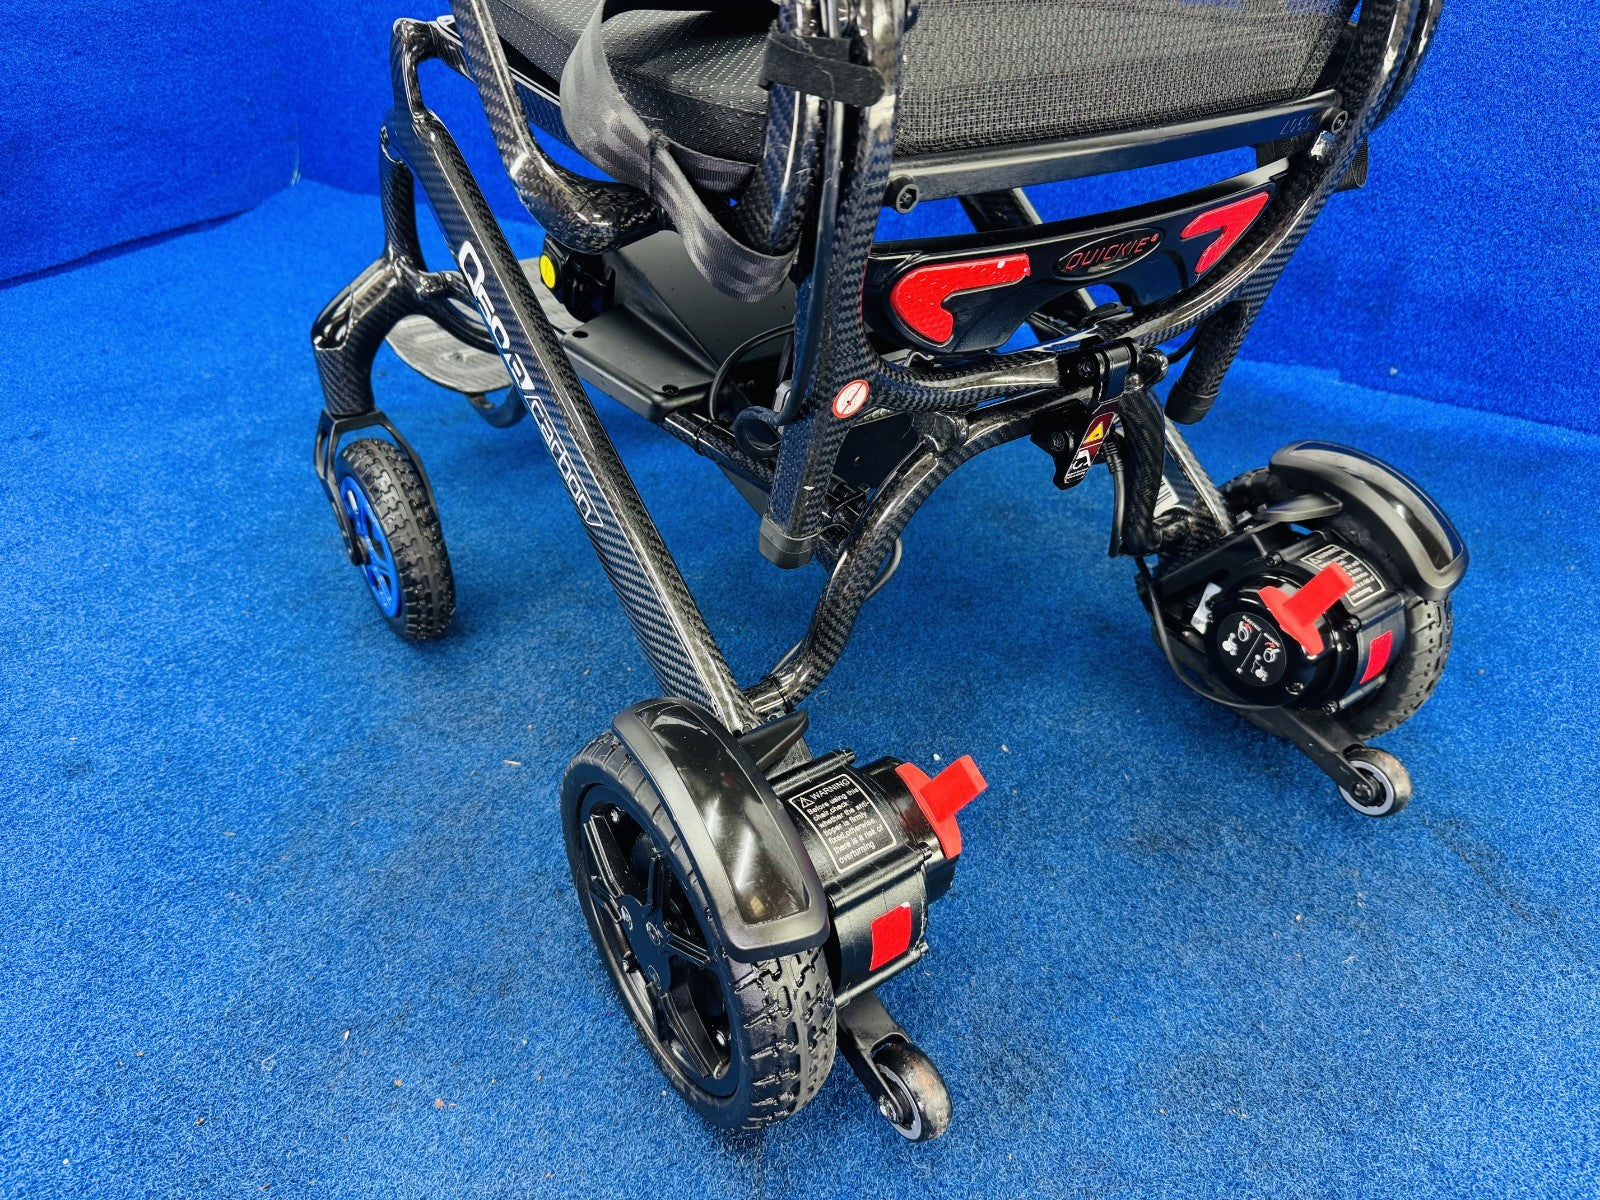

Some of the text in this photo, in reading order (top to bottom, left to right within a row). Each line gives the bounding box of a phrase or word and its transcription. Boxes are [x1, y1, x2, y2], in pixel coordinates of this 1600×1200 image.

[1066, 236, 1151, 271] QUICKIE
[530, 398, 594, 519] carbon
[806, 787, 860, 815] Before using this
[809, 778, 851, 801] WARNING
[818, 800, 870, 829] whether the anti-
[823, 824, 842, 837] tipper
[849, 811, 868, 823] firmly
[833, 840, 852, 854] there
[851, 836, 858, 845] is
[864, 827, 877, 839] risk
[877, 824, 884, 832] of
[838, 840, 876, 864] overturning
